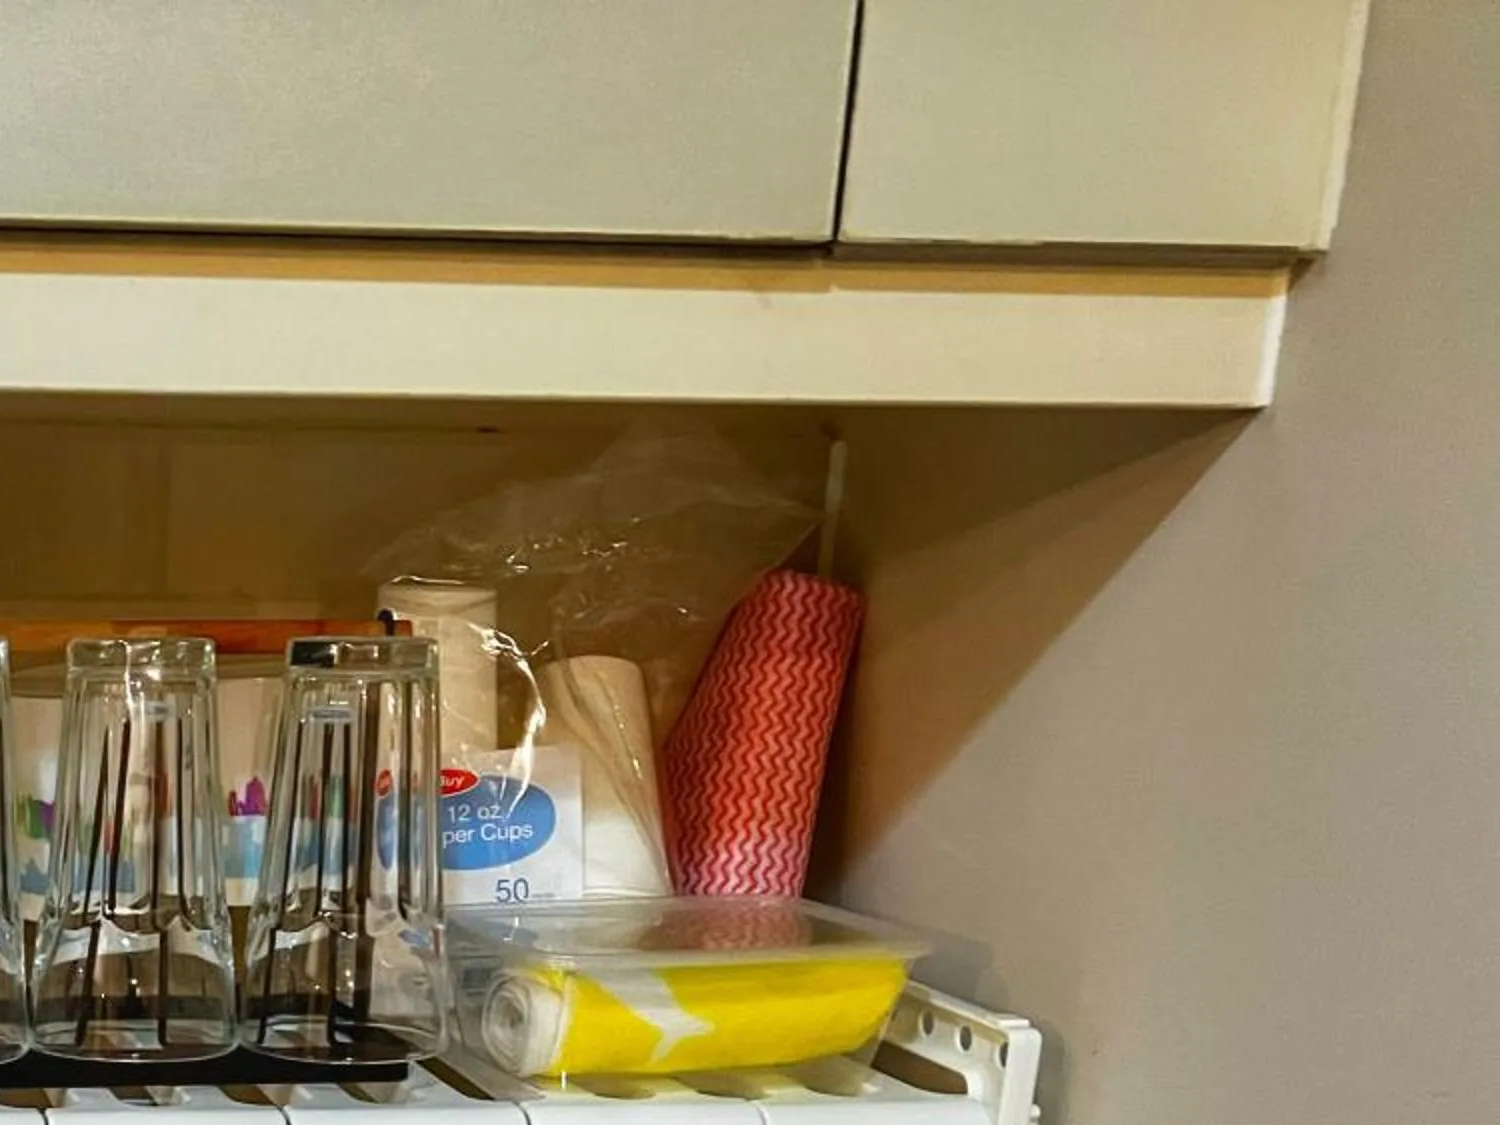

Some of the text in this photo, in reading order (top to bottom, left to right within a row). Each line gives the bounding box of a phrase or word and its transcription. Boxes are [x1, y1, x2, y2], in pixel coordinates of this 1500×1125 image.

[448, 803, 471, 823] 12
[441, 823, 533, 849] per Cups
[495, 877, 529, 903] 50
